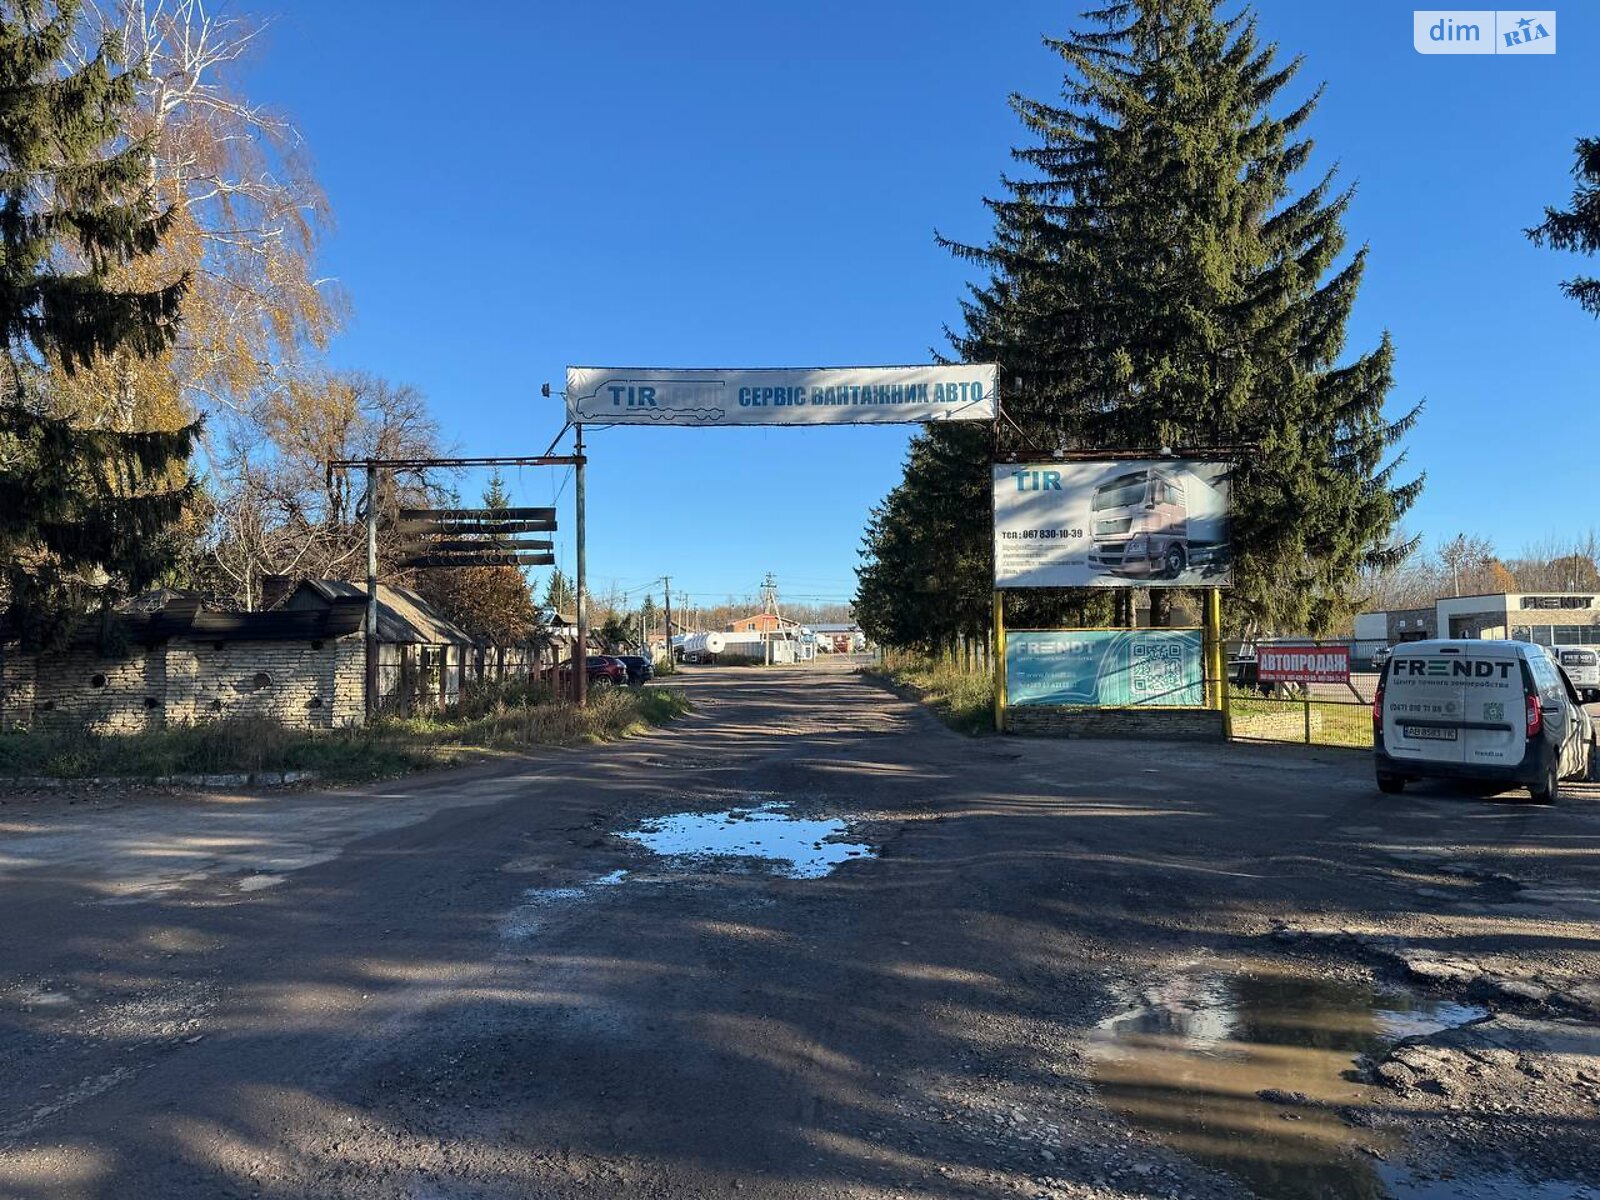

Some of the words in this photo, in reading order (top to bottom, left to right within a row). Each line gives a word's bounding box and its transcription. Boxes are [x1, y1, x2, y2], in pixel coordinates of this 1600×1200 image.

[607, 385, 658, 407] TIR
[738, 386, 806, 408] СЕРВІС
[933, 381, 984, 403] АВТО
[1011, 470, 1063, 491] TIR
[1016, 641, 1097, 654] FRENDT
[1260, 653, 1347, 673] АВТОПРОДАЖ
[1393, 660, 1514, 679] FRENDT
